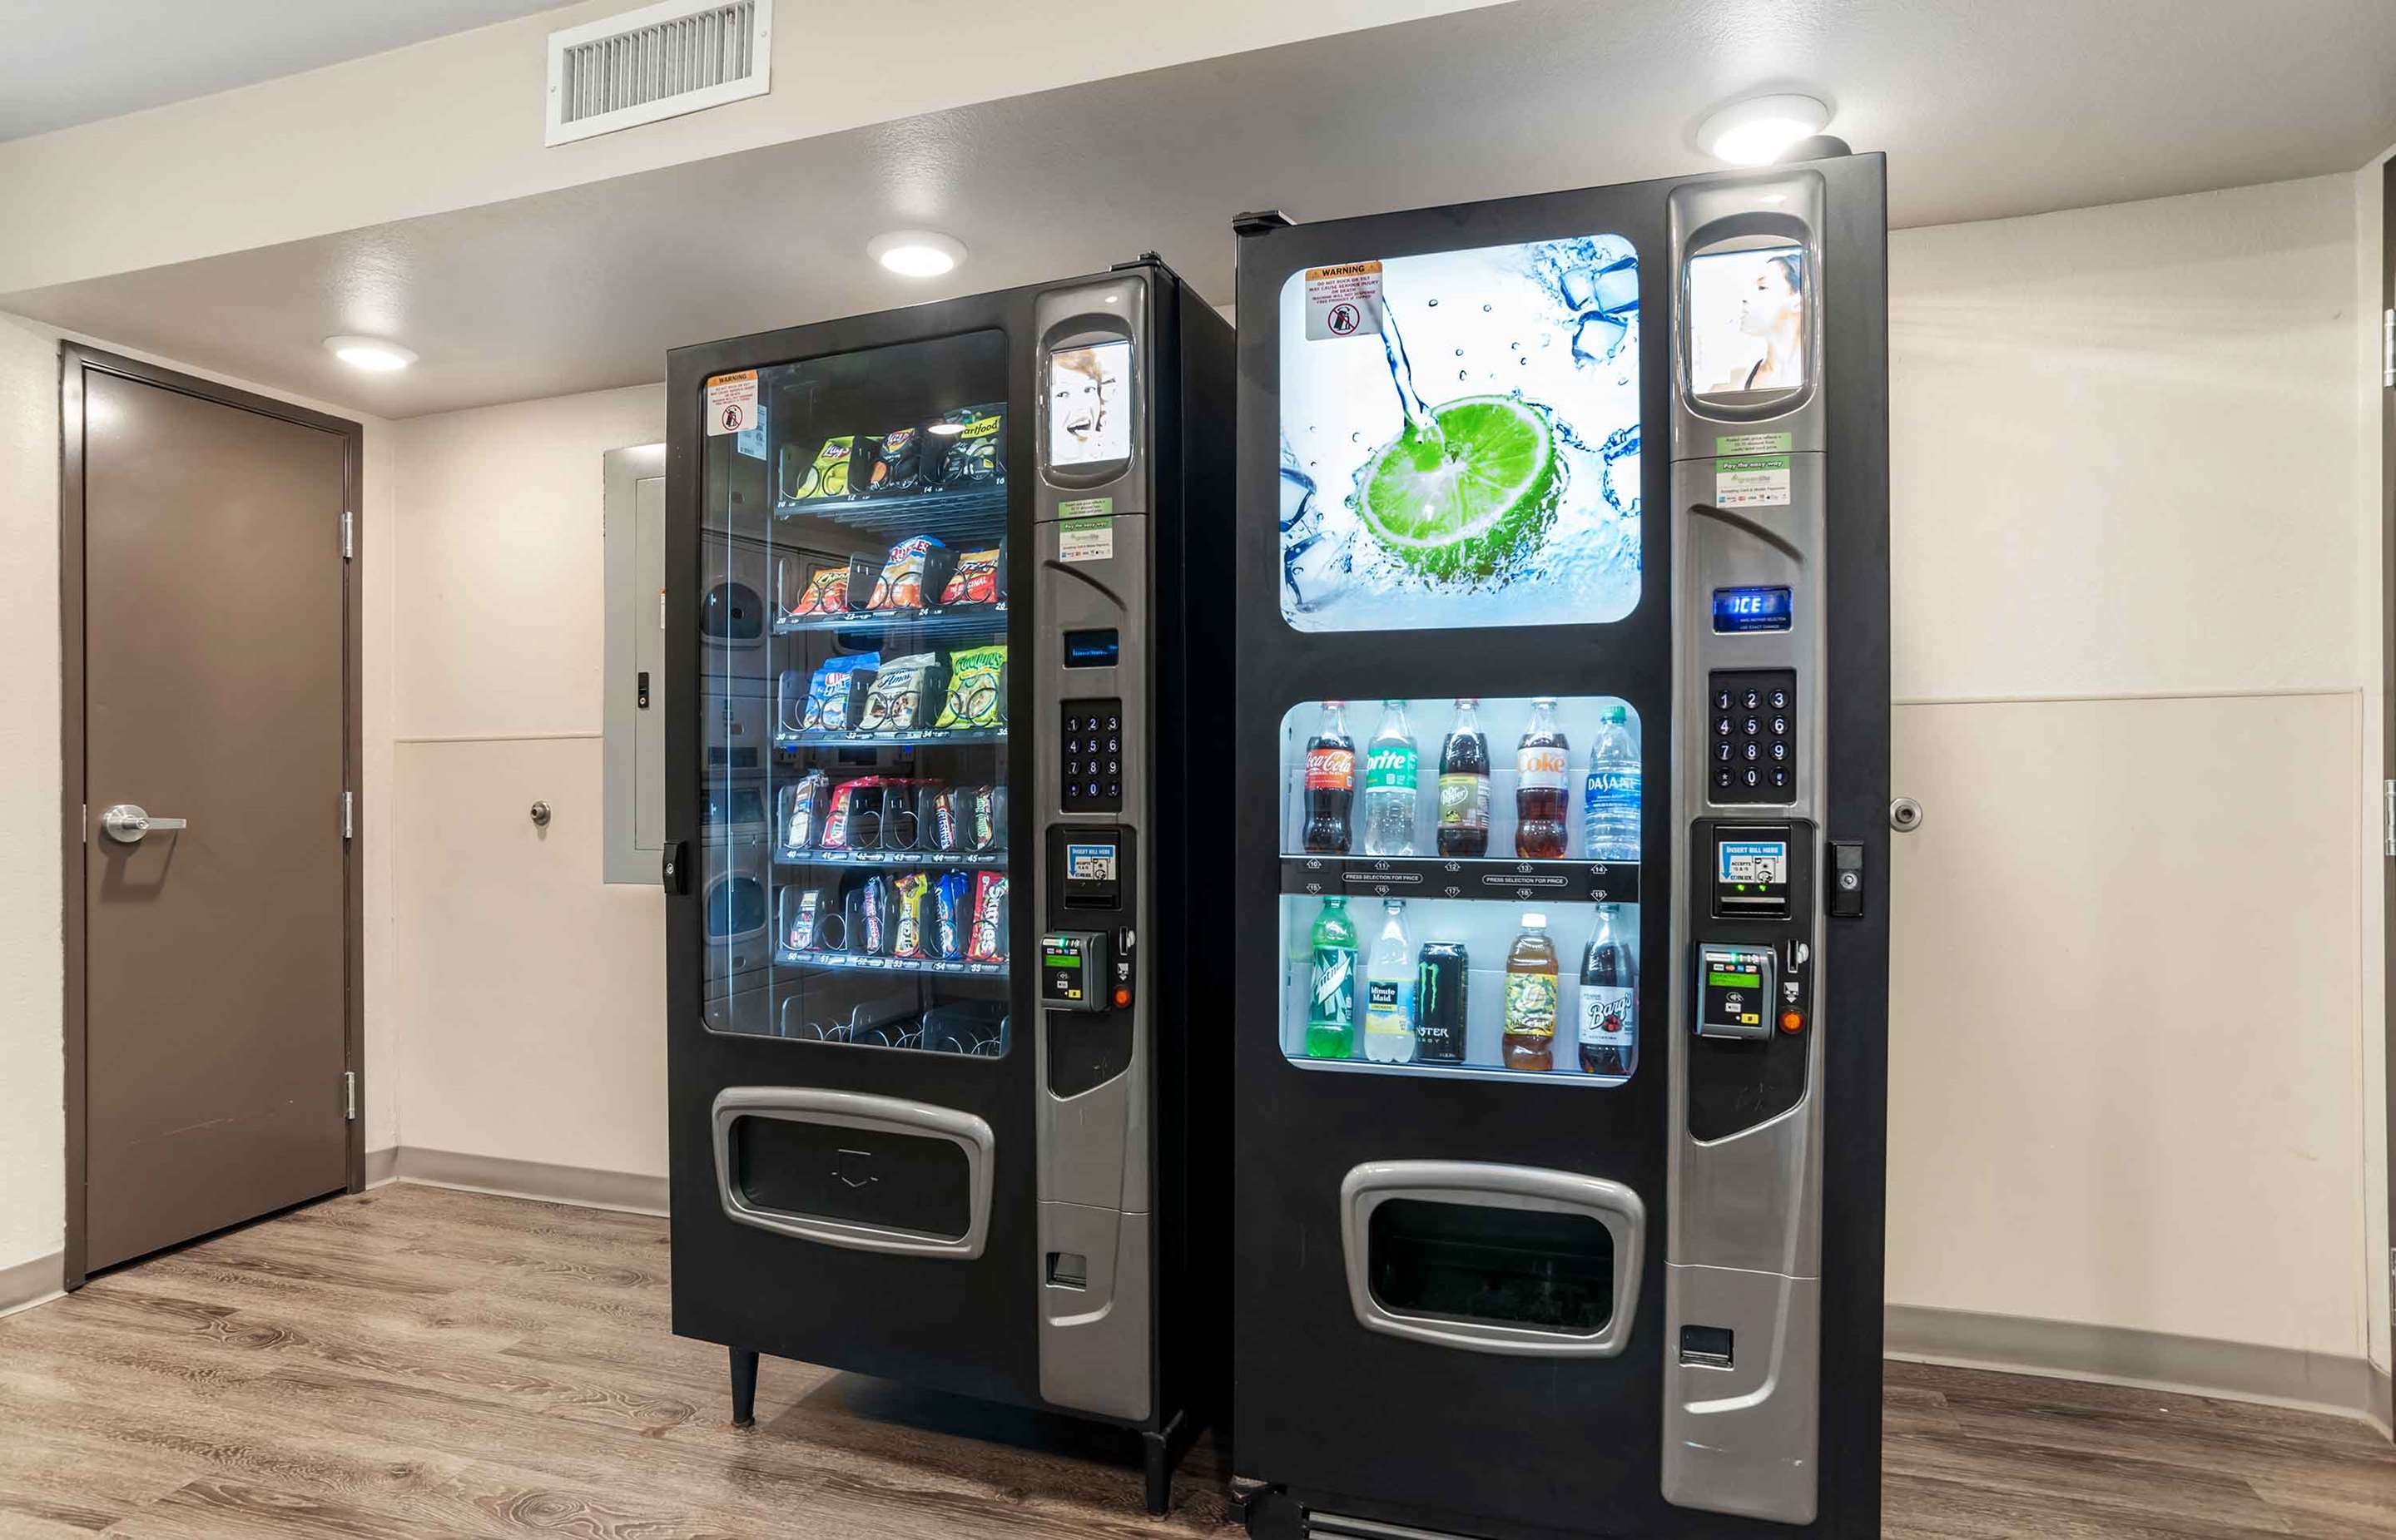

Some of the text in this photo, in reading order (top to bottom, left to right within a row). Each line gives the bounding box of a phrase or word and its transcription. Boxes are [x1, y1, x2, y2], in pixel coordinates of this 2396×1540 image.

[1322, 265, 1365, 276] WARNING
[718, 374, 747, 384] WARNING
[1734, 597, 1761, 613] ICE
[1721, 692, 1784, 707] 1 2 3
[1070, 717, 1116, 730] 1 2 3
[1720, 718, 1784, 732] 4 5 6
[1070, 739, 1117, 752] 4 5 6
[1721, 745, 1784, 758] 7 8 9
[1367, 750, 1406, 770] prite
[1070, 761, 1117, 773] 7 8 9
[1748, 770, 1756, 784] 0
[1090, 783, 1097, 795] 0
[1727, 845, 1748, 854] INSERT
[1372, 986, 1396, 996] Minute
